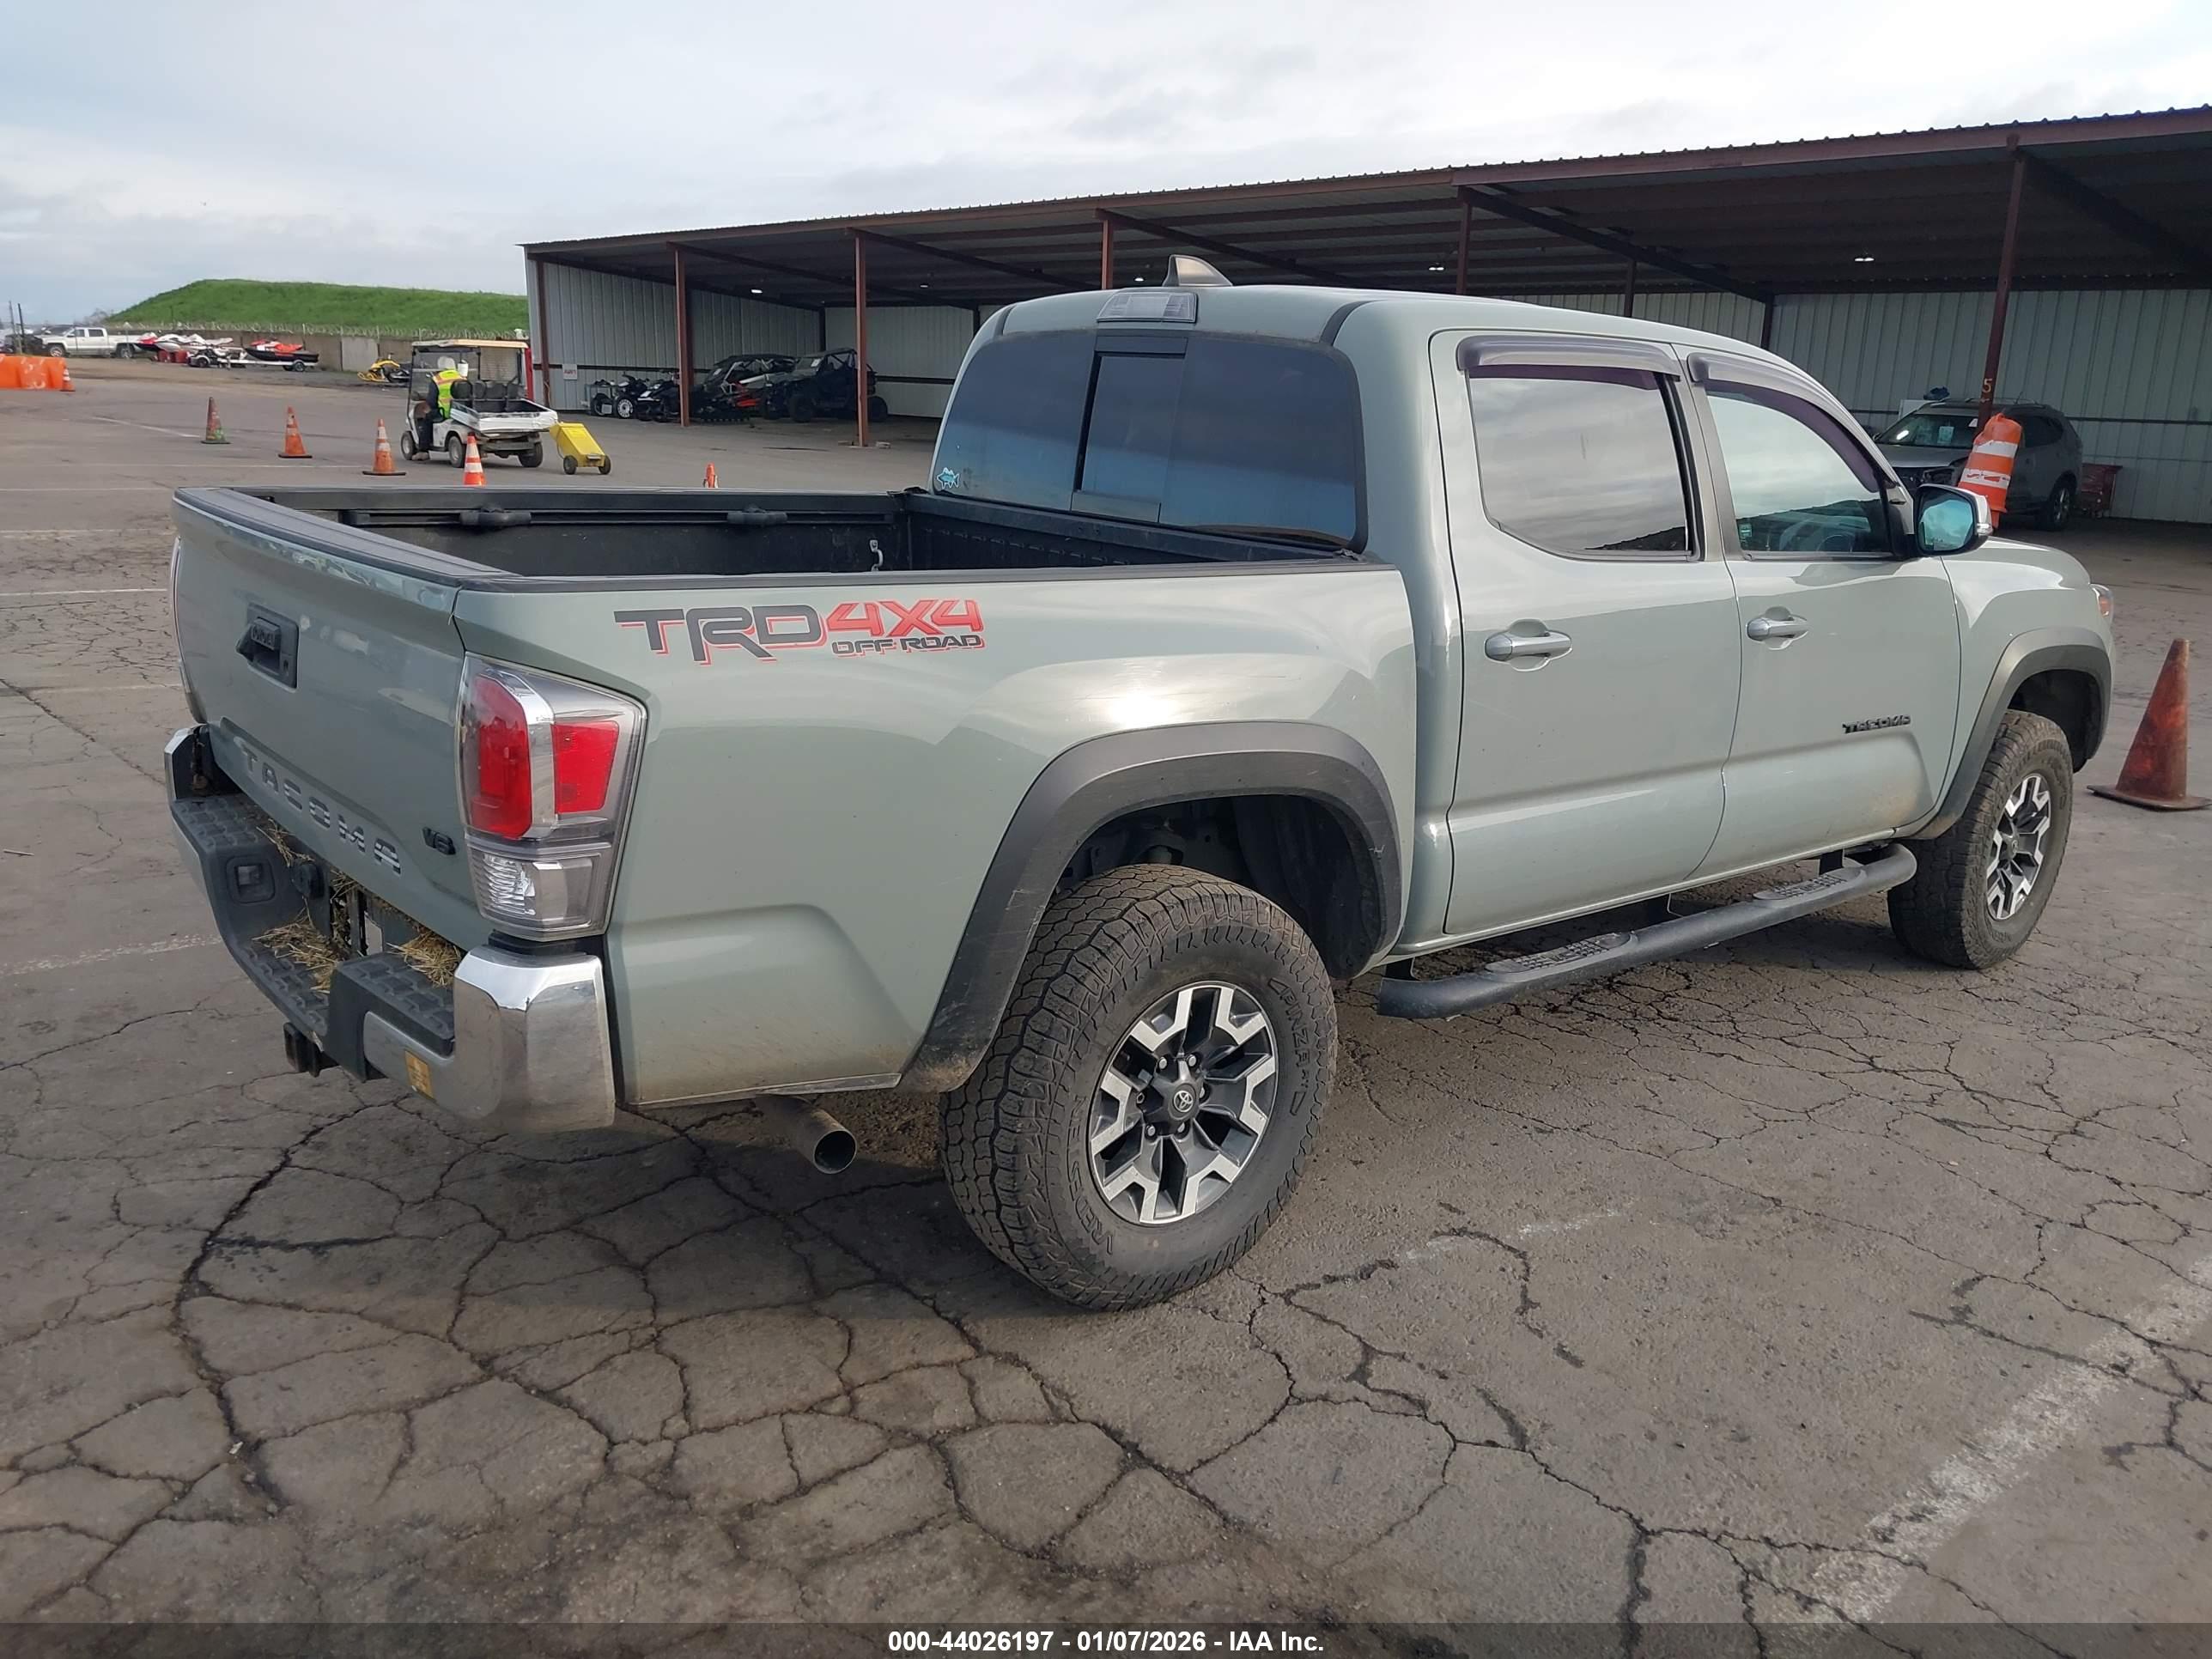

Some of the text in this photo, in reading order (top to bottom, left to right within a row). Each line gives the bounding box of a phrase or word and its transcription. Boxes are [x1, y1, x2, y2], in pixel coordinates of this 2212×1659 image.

[614, 604, 827, 665] TRD
[831, 634, 985, 657] OFF ROAD
[240, 744, 401, 875] TACOMA
[1066, 1095, 1114, 1255] VREDESEN
